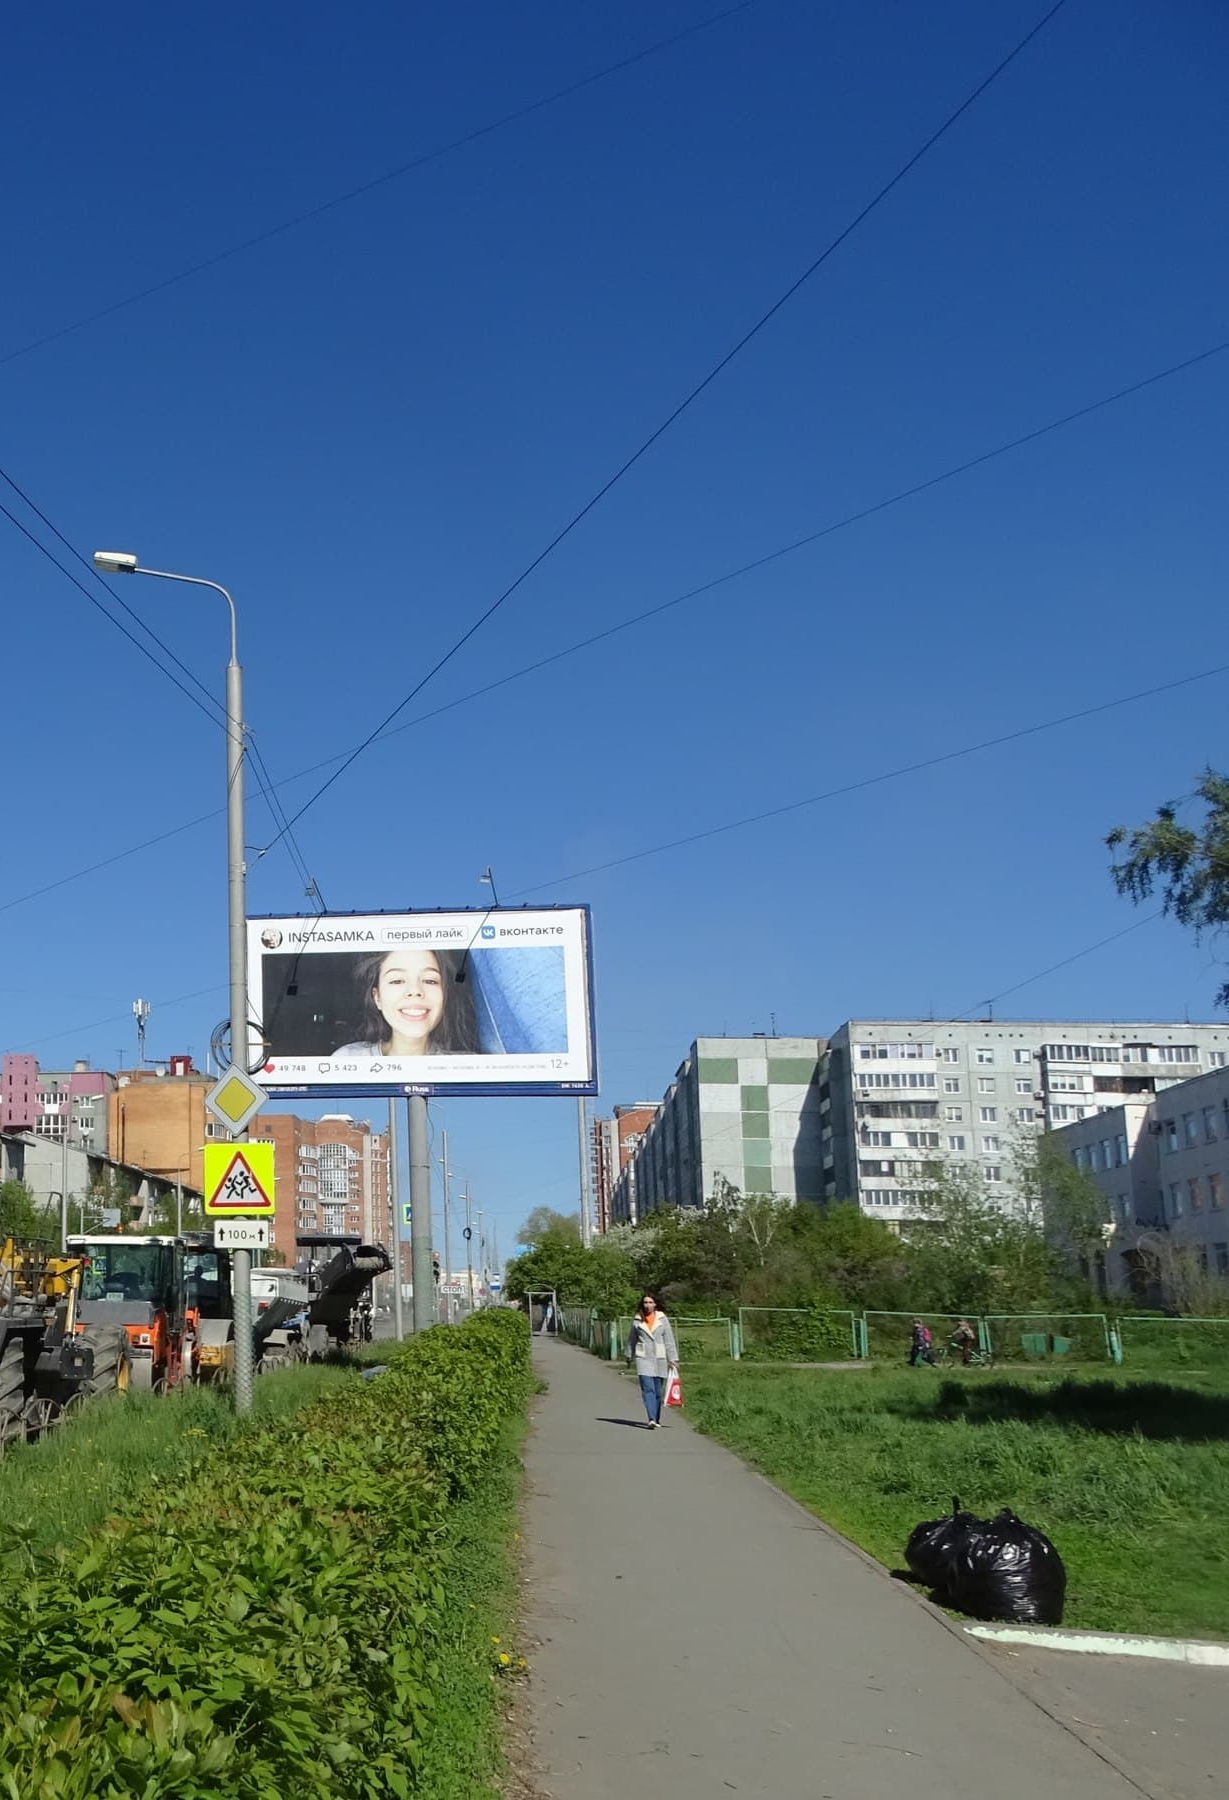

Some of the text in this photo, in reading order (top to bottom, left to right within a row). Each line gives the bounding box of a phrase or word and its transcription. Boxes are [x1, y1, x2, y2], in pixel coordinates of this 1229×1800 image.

[288, 930, 375, 943] INSTASAMKA
[386, 928, 463, 940] первый лайк
[342, 1064, 358, 1072] 423
[550, 1058, 570, 1069] 12+
[228, 1229, 247, 1240] 100
